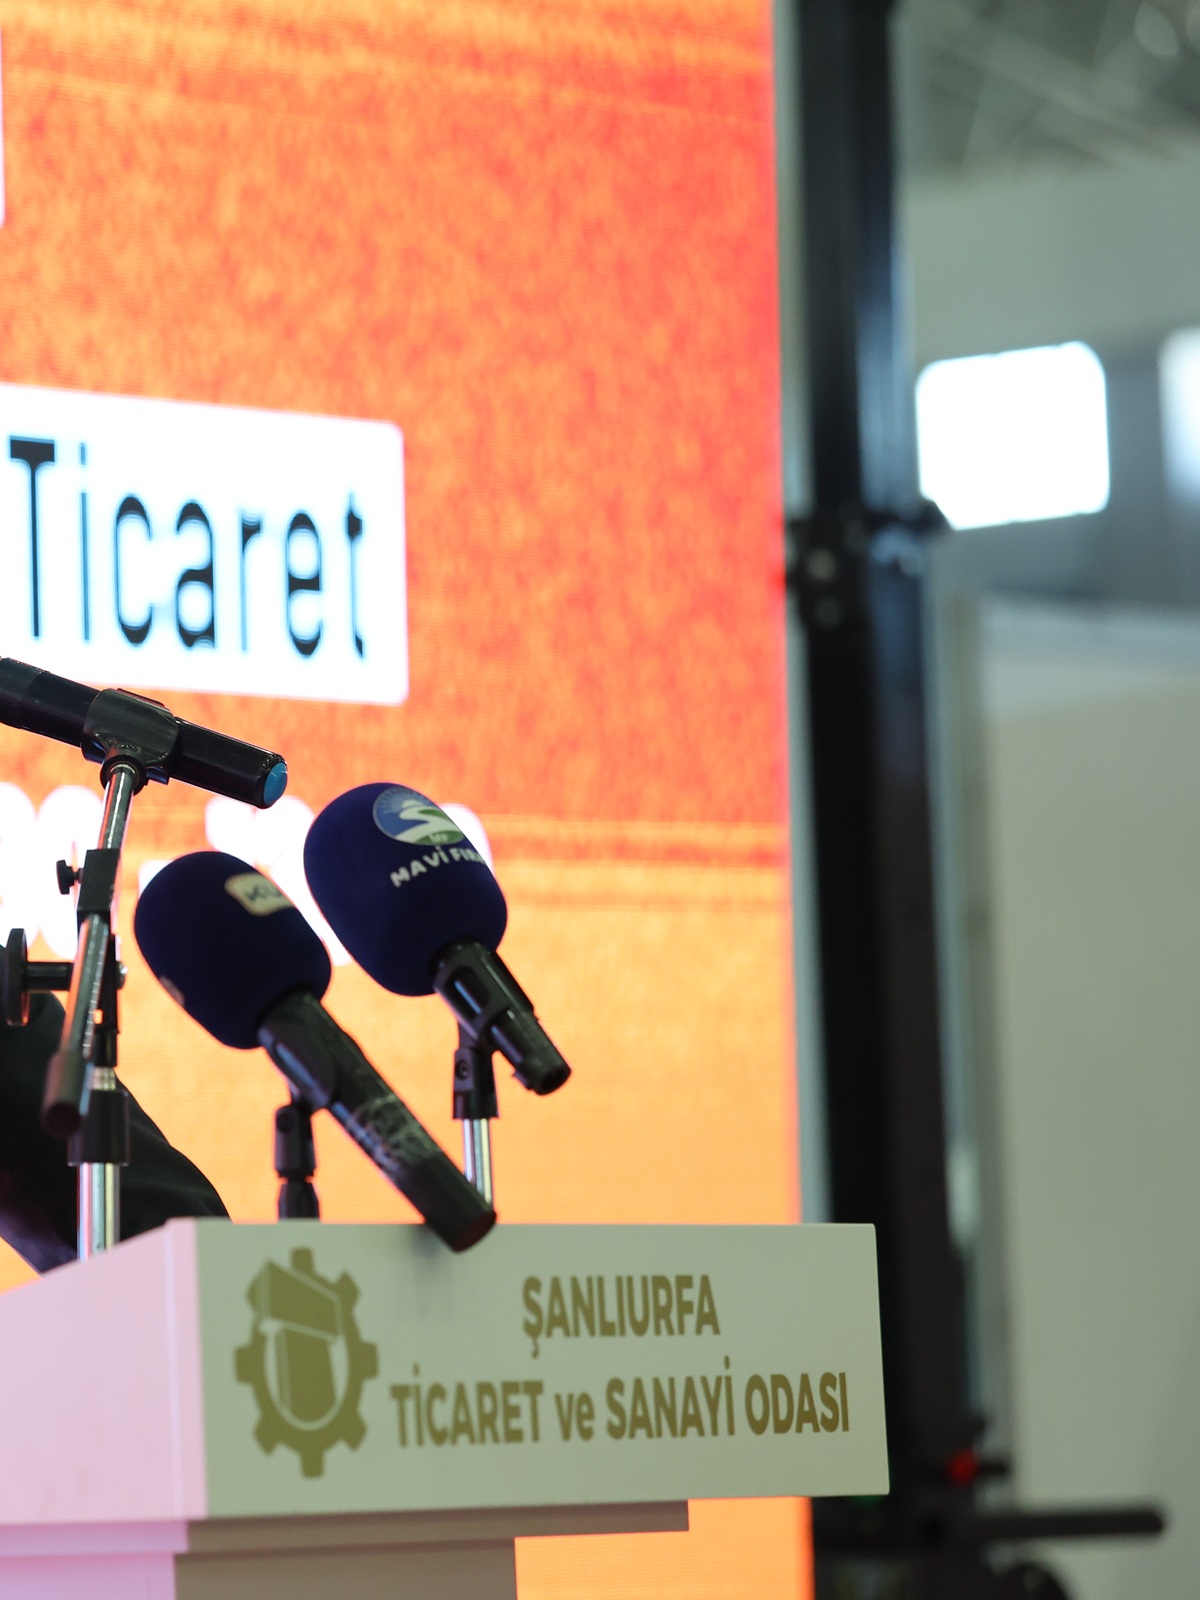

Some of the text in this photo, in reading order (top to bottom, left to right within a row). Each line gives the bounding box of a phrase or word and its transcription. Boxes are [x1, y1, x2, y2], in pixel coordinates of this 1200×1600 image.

[390, 845, 449, 887] MAVİ
[522, 1274, 720, 1358] ŞANLIURFA
[390, 1355, 850, 1447] TİCARET ve SANAYİ ODASI
